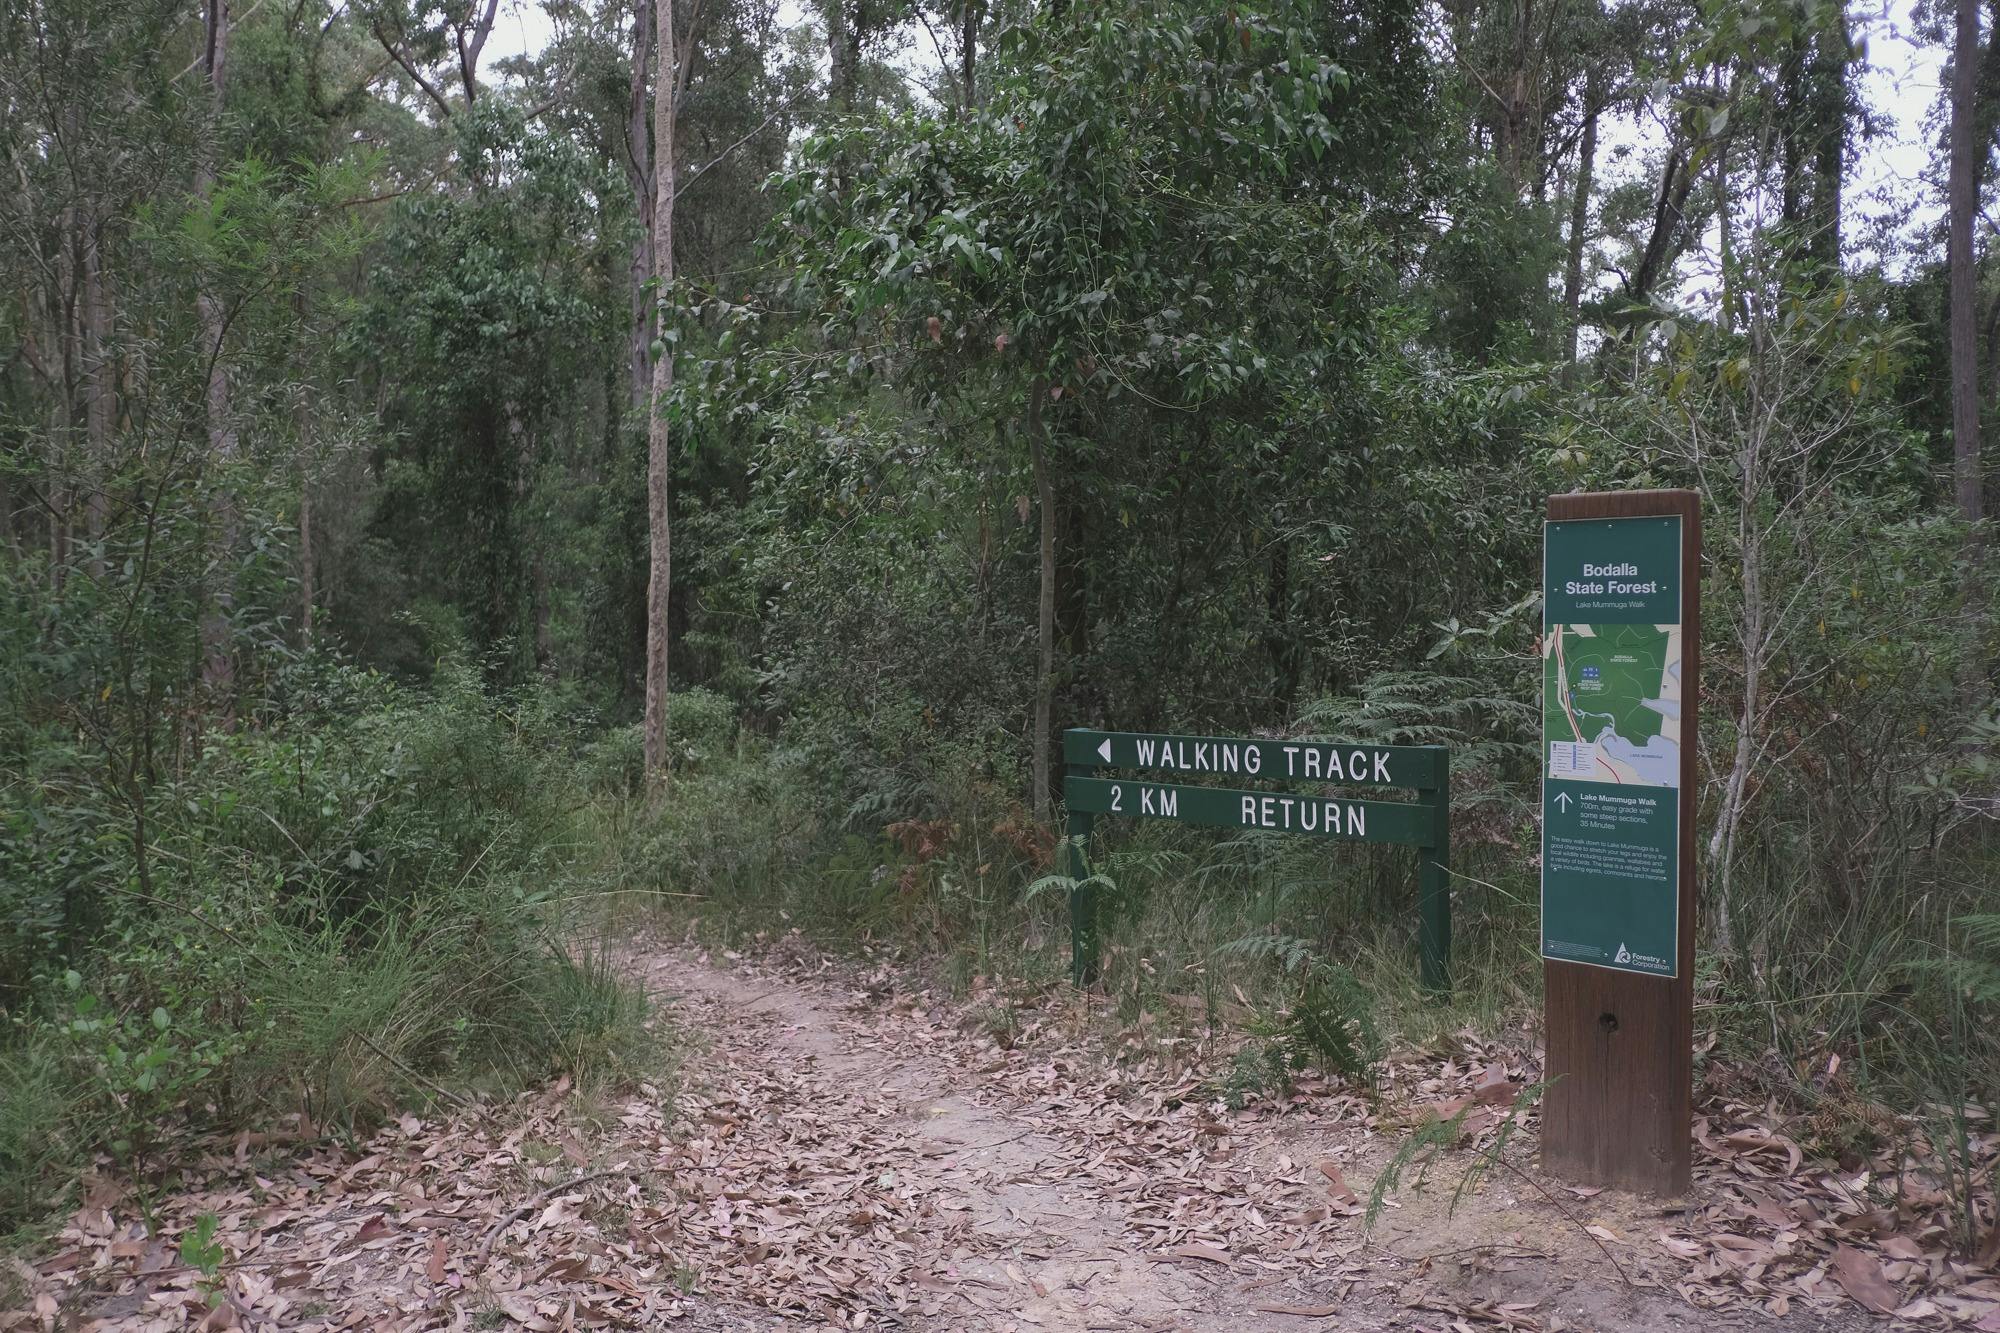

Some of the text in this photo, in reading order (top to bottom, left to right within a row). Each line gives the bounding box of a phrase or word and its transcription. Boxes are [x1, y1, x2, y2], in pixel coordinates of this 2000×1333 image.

[1583, 563, 1638, 576] Bodalla
[1565, 580, 1656, 594] State Forest
[1136, 739, 1392, 783] WALKING TRACK
[1580, 793, 1657, 806] Lake Mummuga Walk
[1110, 784, 1366, 836] 2 KM RETURN
[1601, 805, 1617, 813] easy
[1618, 806, 1638, 814] grade
[1639, 807, 1654, 815] with
[1599, 813, 1617, 821] steep
[1590, 820, 1615, 830] Minutes
[1632, 952, 1660, 964] Forestry
[1631, 959, 1670, 971] Corporation
